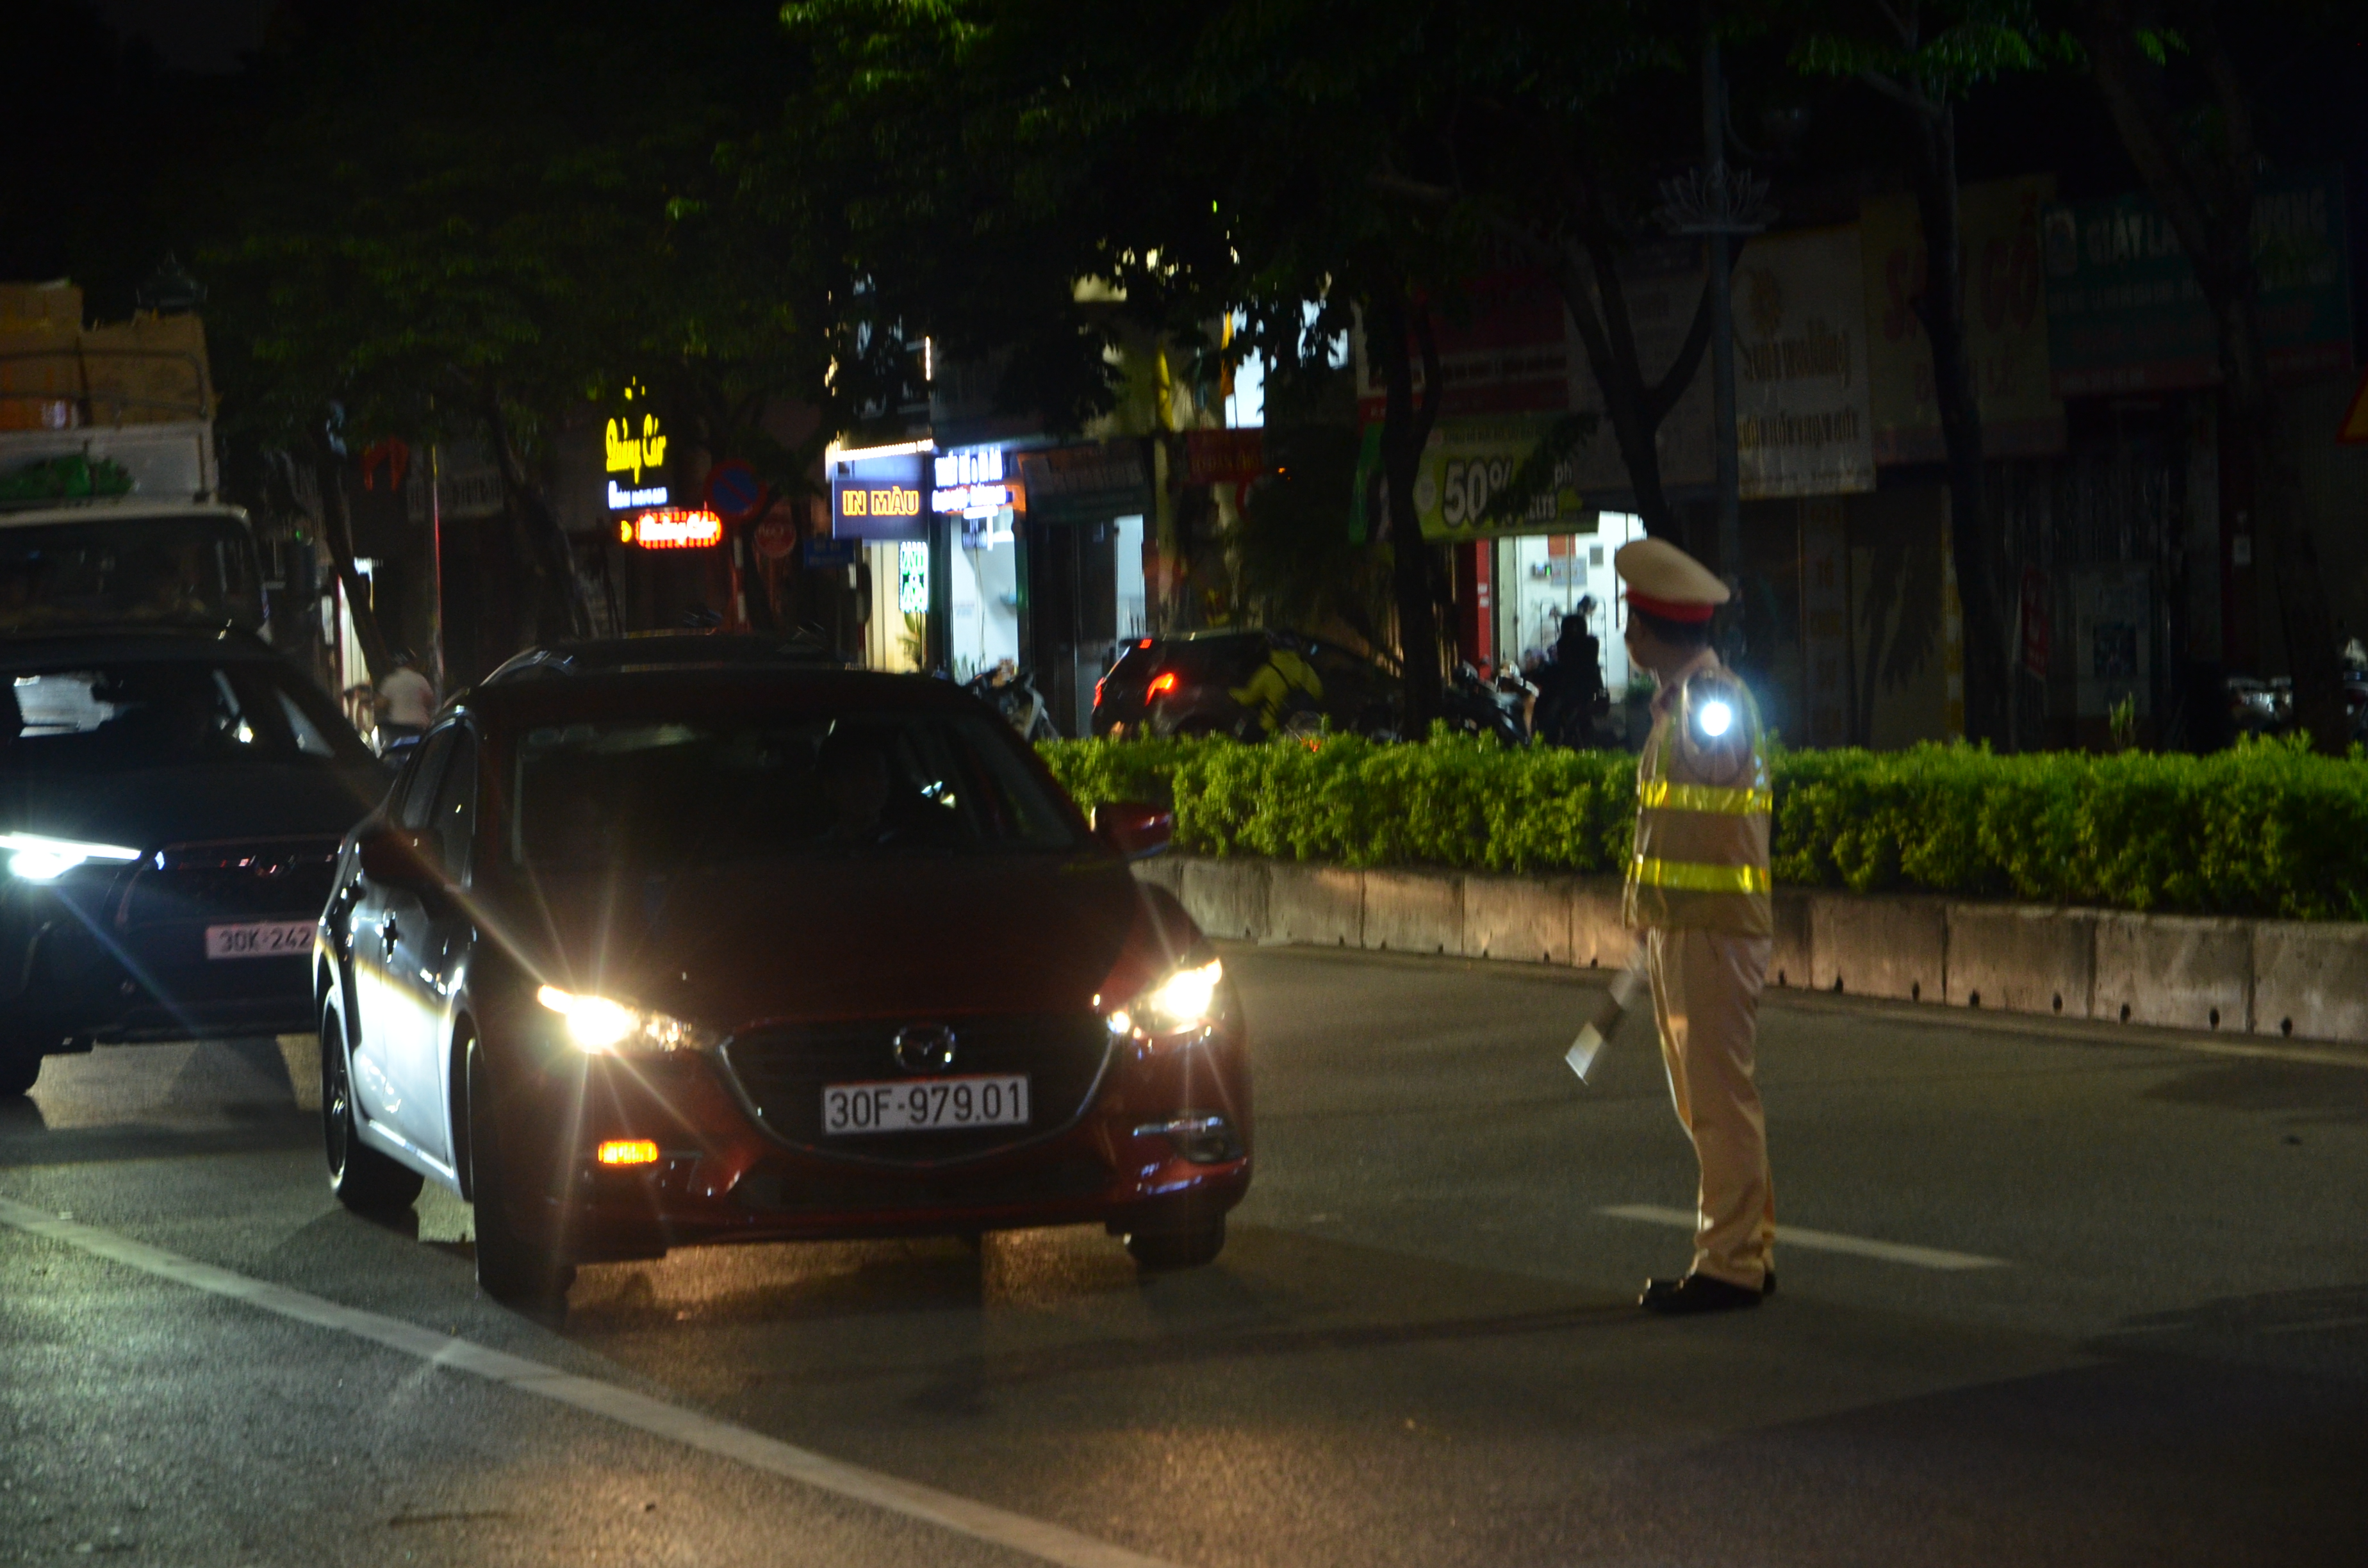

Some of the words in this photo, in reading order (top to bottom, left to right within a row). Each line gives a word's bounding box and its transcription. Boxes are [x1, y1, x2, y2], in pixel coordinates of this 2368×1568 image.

[843, 490, 867, 516] IN
[871, 485, 919, 516] MÀU
[830, 1081, 1020, 1128] 30F-979.01
